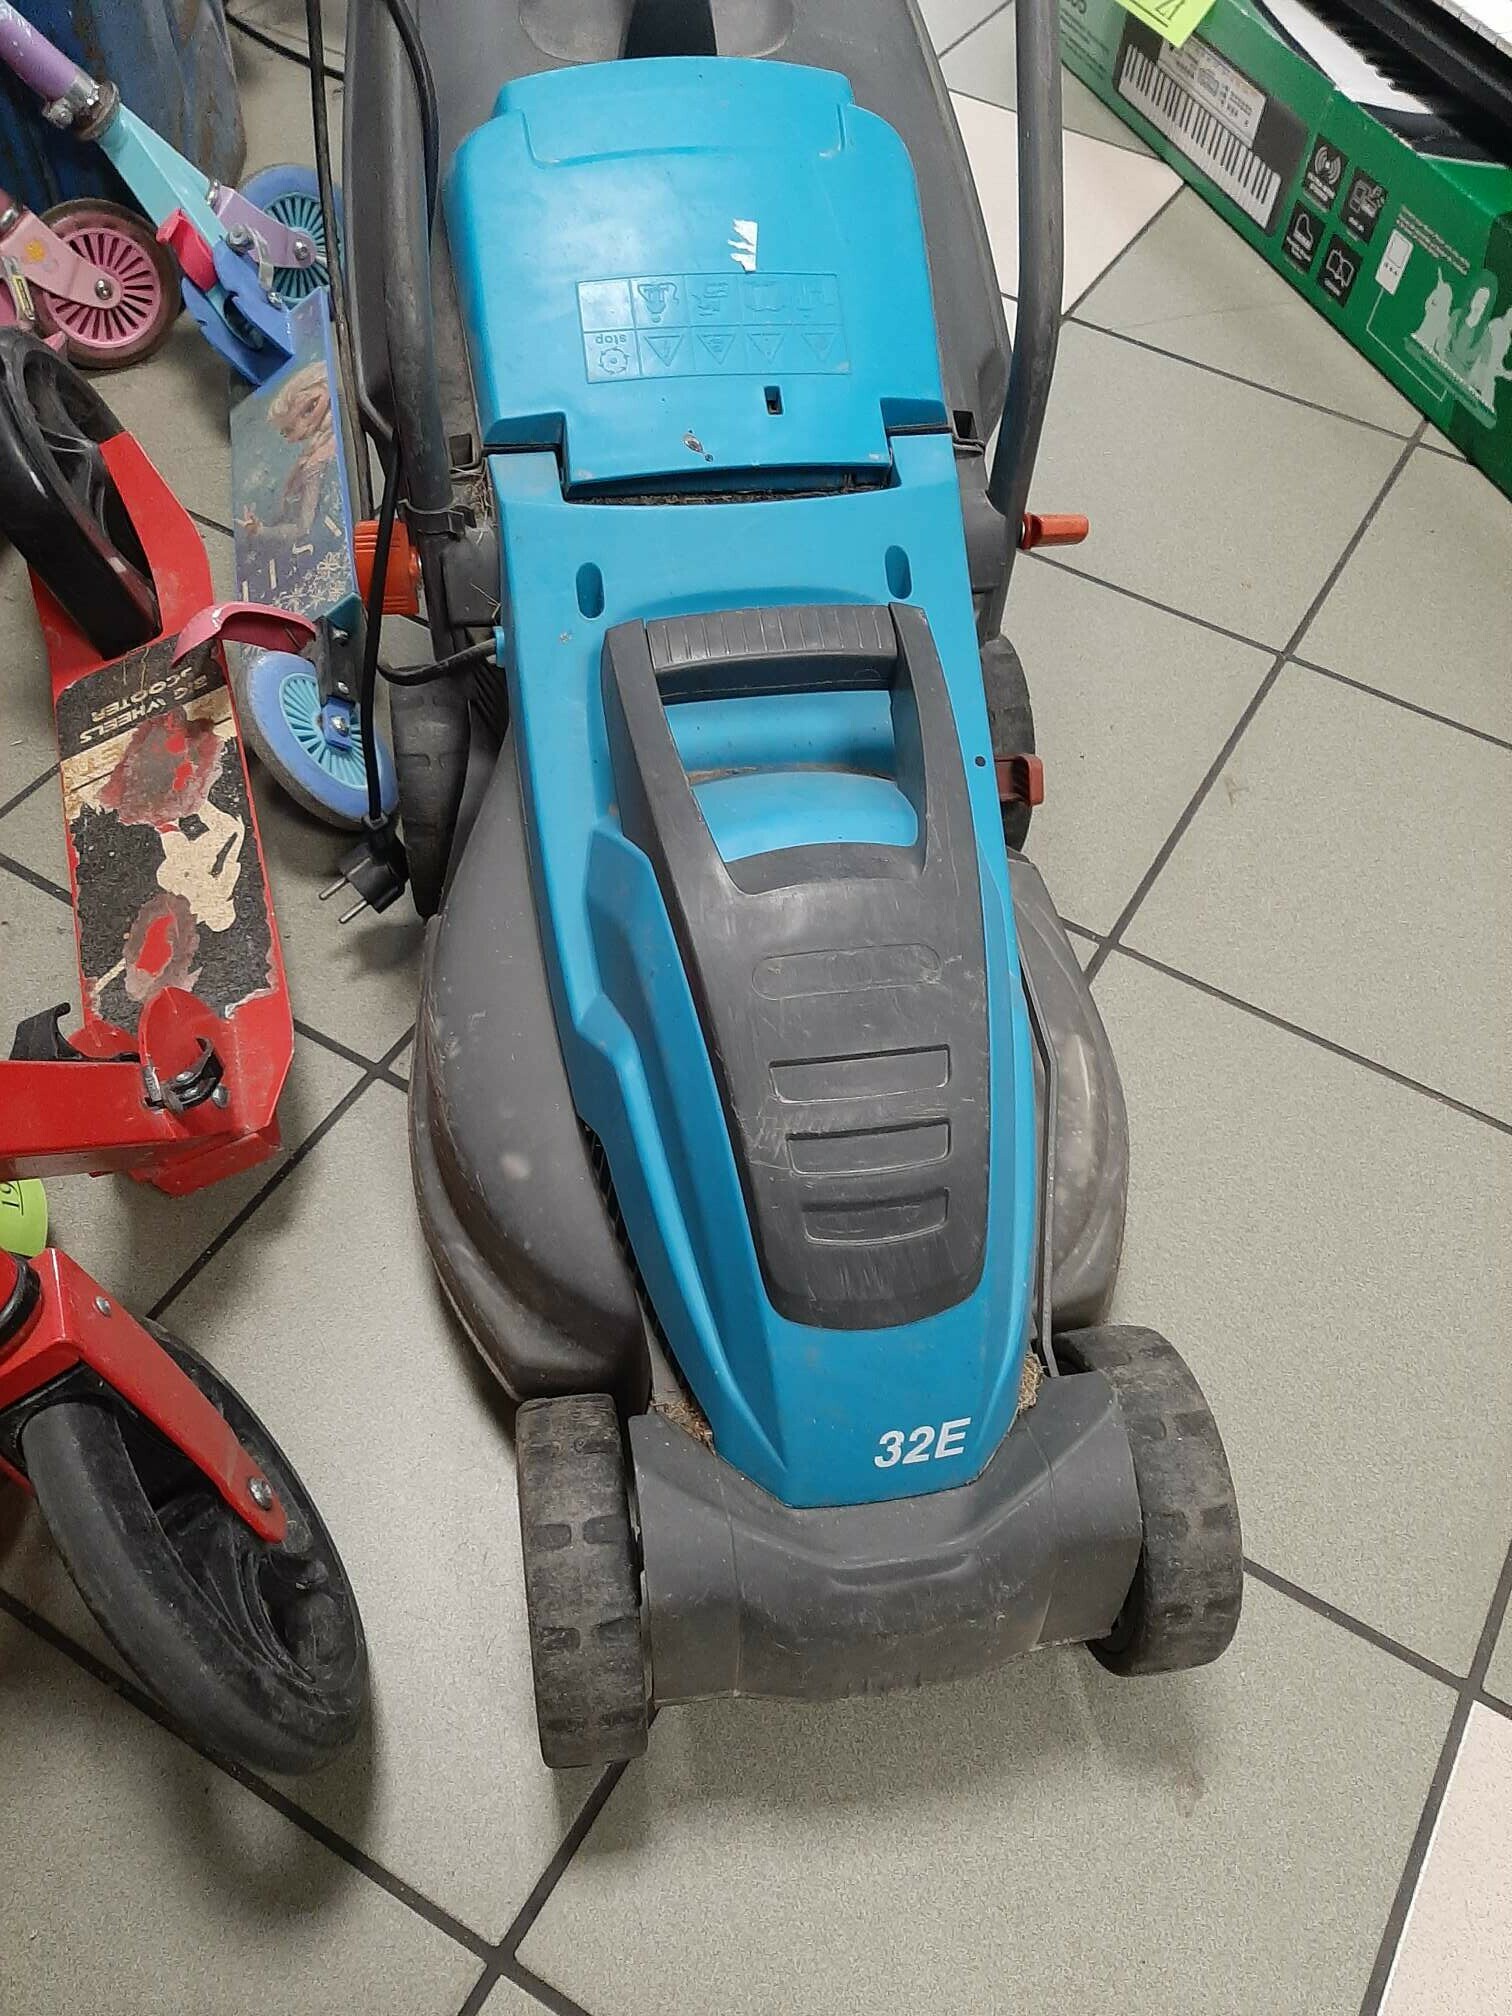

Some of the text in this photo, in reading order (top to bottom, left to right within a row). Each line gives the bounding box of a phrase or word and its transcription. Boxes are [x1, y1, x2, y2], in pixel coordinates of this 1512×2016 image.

[595, 334, 627, 344] stop
[79, 698, 167, 744] WHEELS
[874, 1417, 972, 1468] 32E
